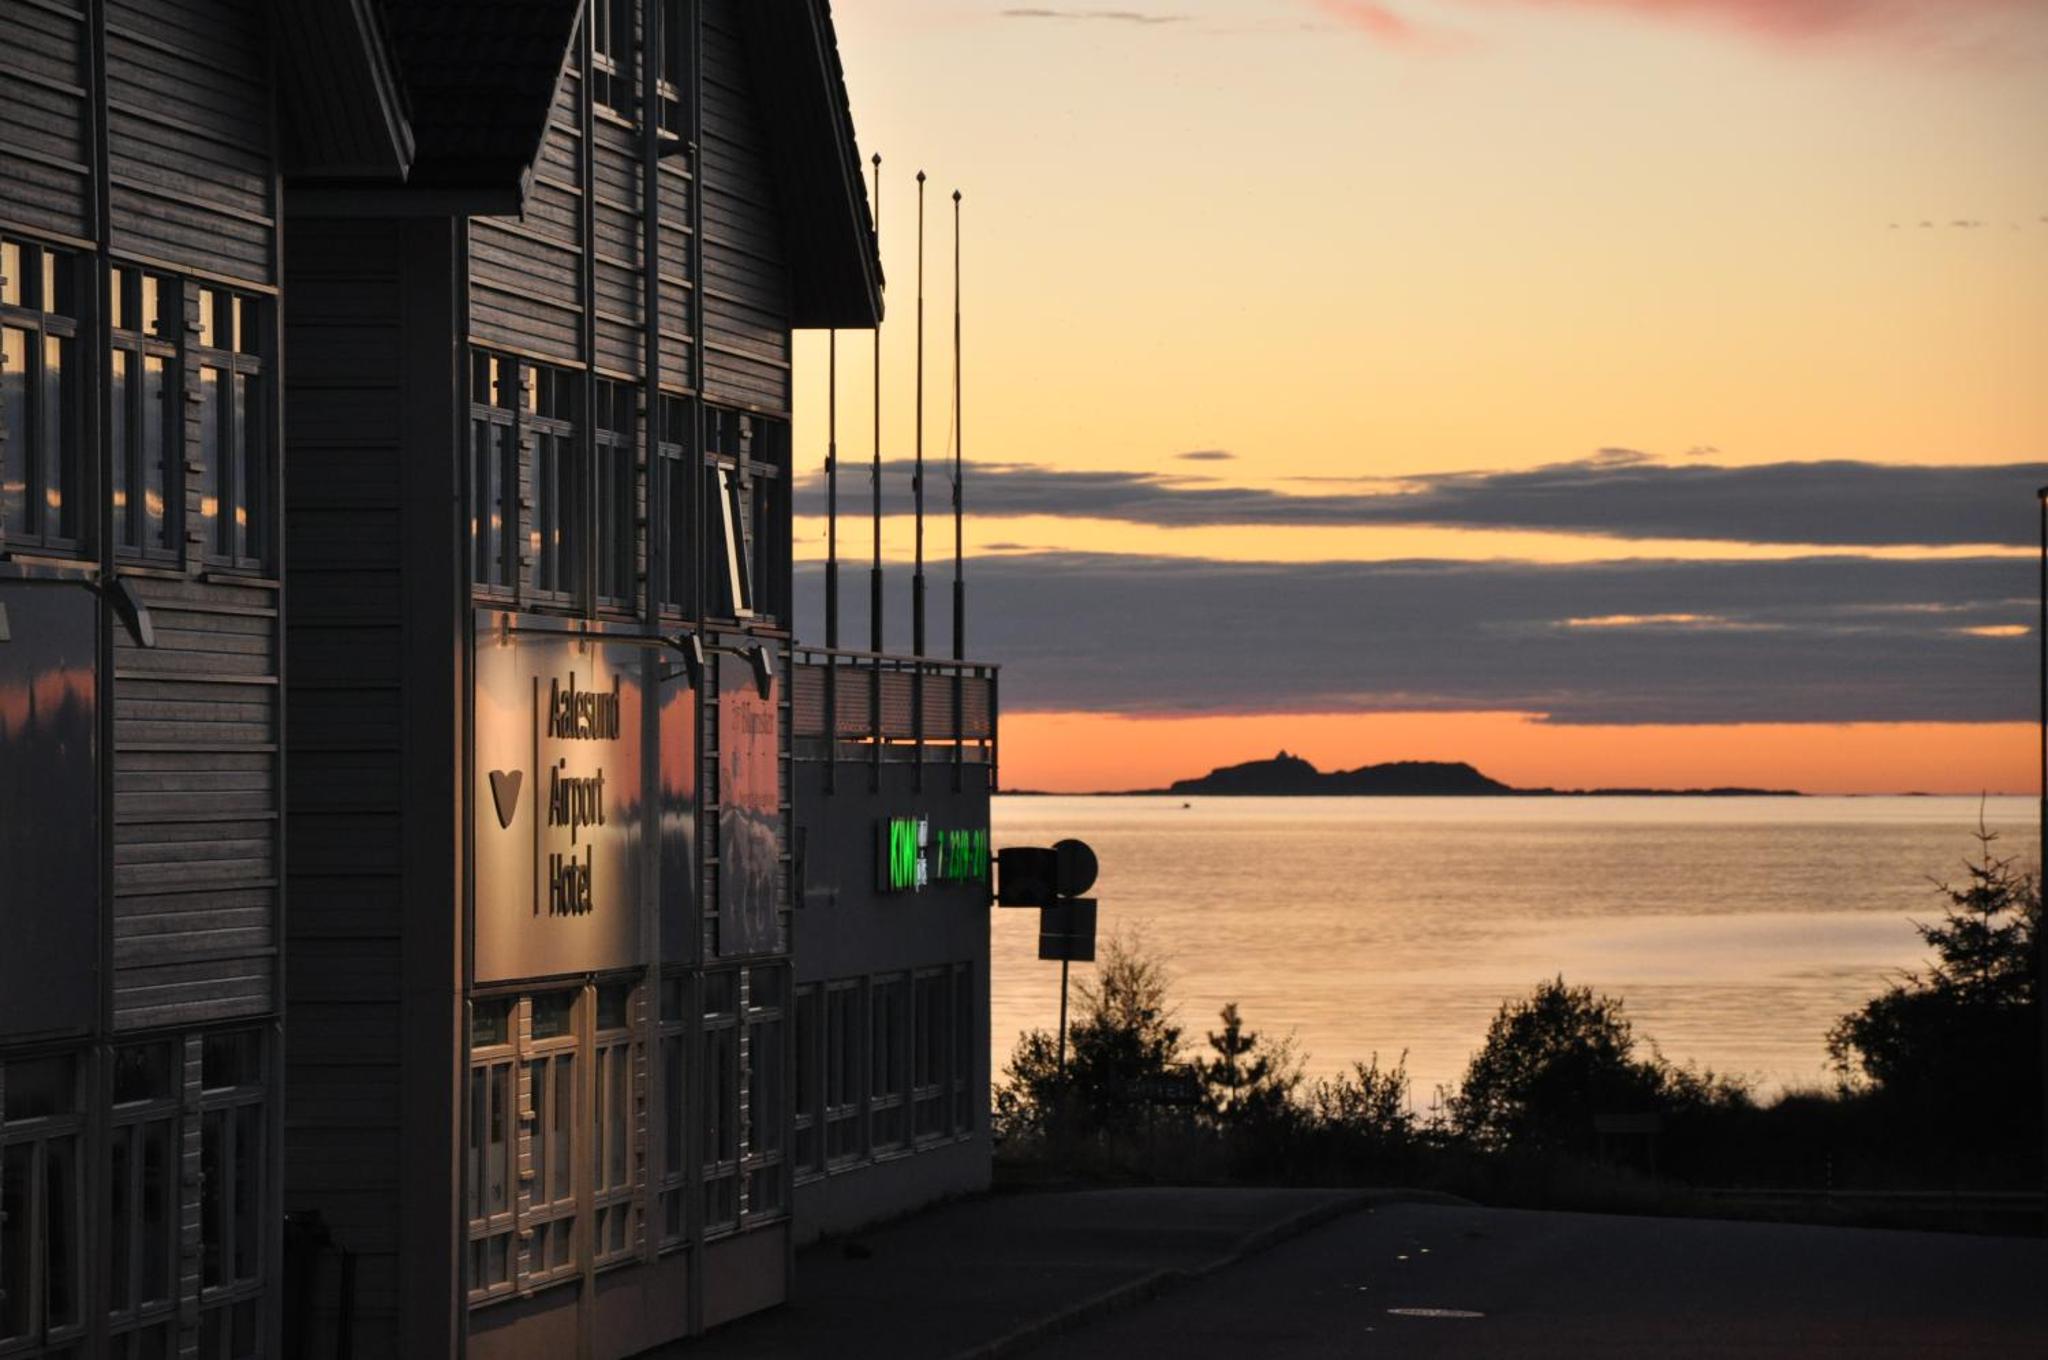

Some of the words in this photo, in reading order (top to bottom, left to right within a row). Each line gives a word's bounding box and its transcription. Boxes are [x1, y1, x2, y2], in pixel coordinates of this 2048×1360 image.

[548, 672, 620, 740] Aalesund
[549, 757, 605, 846] Airport
[549, 845, 593, 917] Hotel
